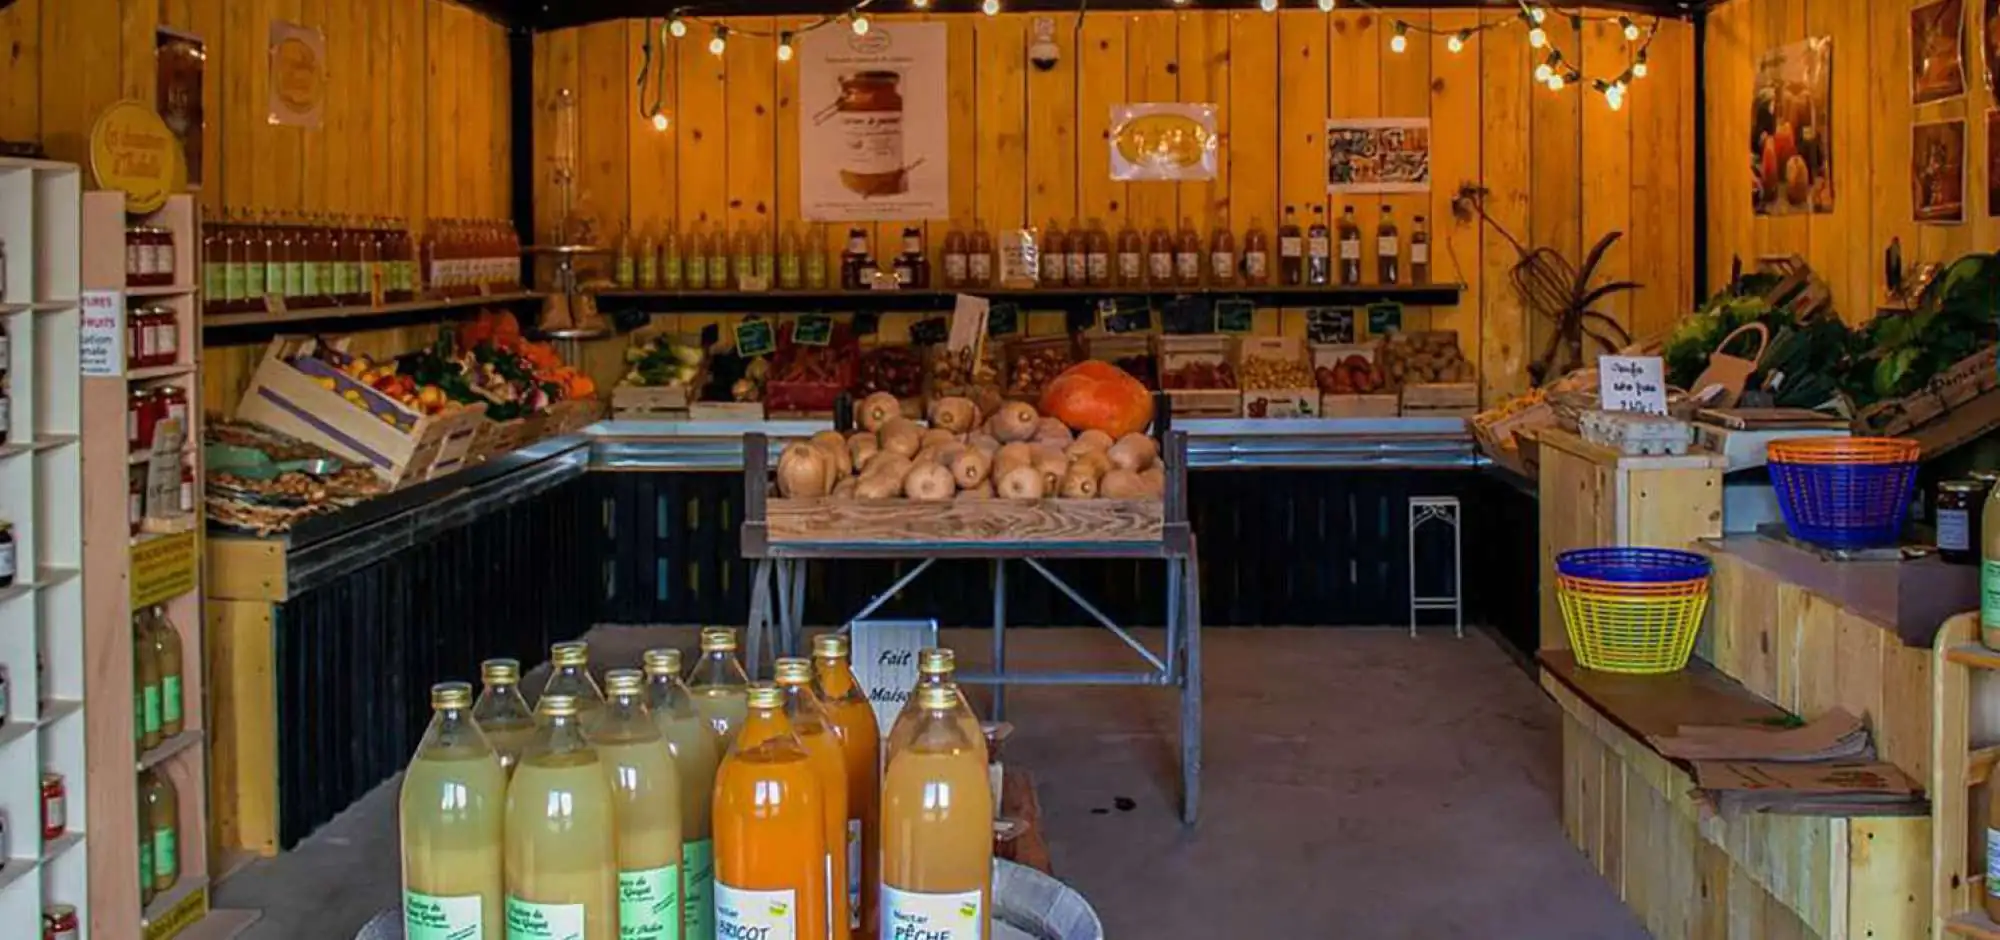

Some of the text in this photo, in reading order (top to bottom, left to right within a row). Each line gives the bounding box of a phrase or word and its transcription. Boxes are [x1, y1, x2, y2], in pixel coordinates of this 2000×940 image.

[878, 649, 912, 666] Fait
[869, 687, 906, 703] Maiso
[893, 909, 928, 922] Nectar
[895, 923, 951, 940] PÊCHE
